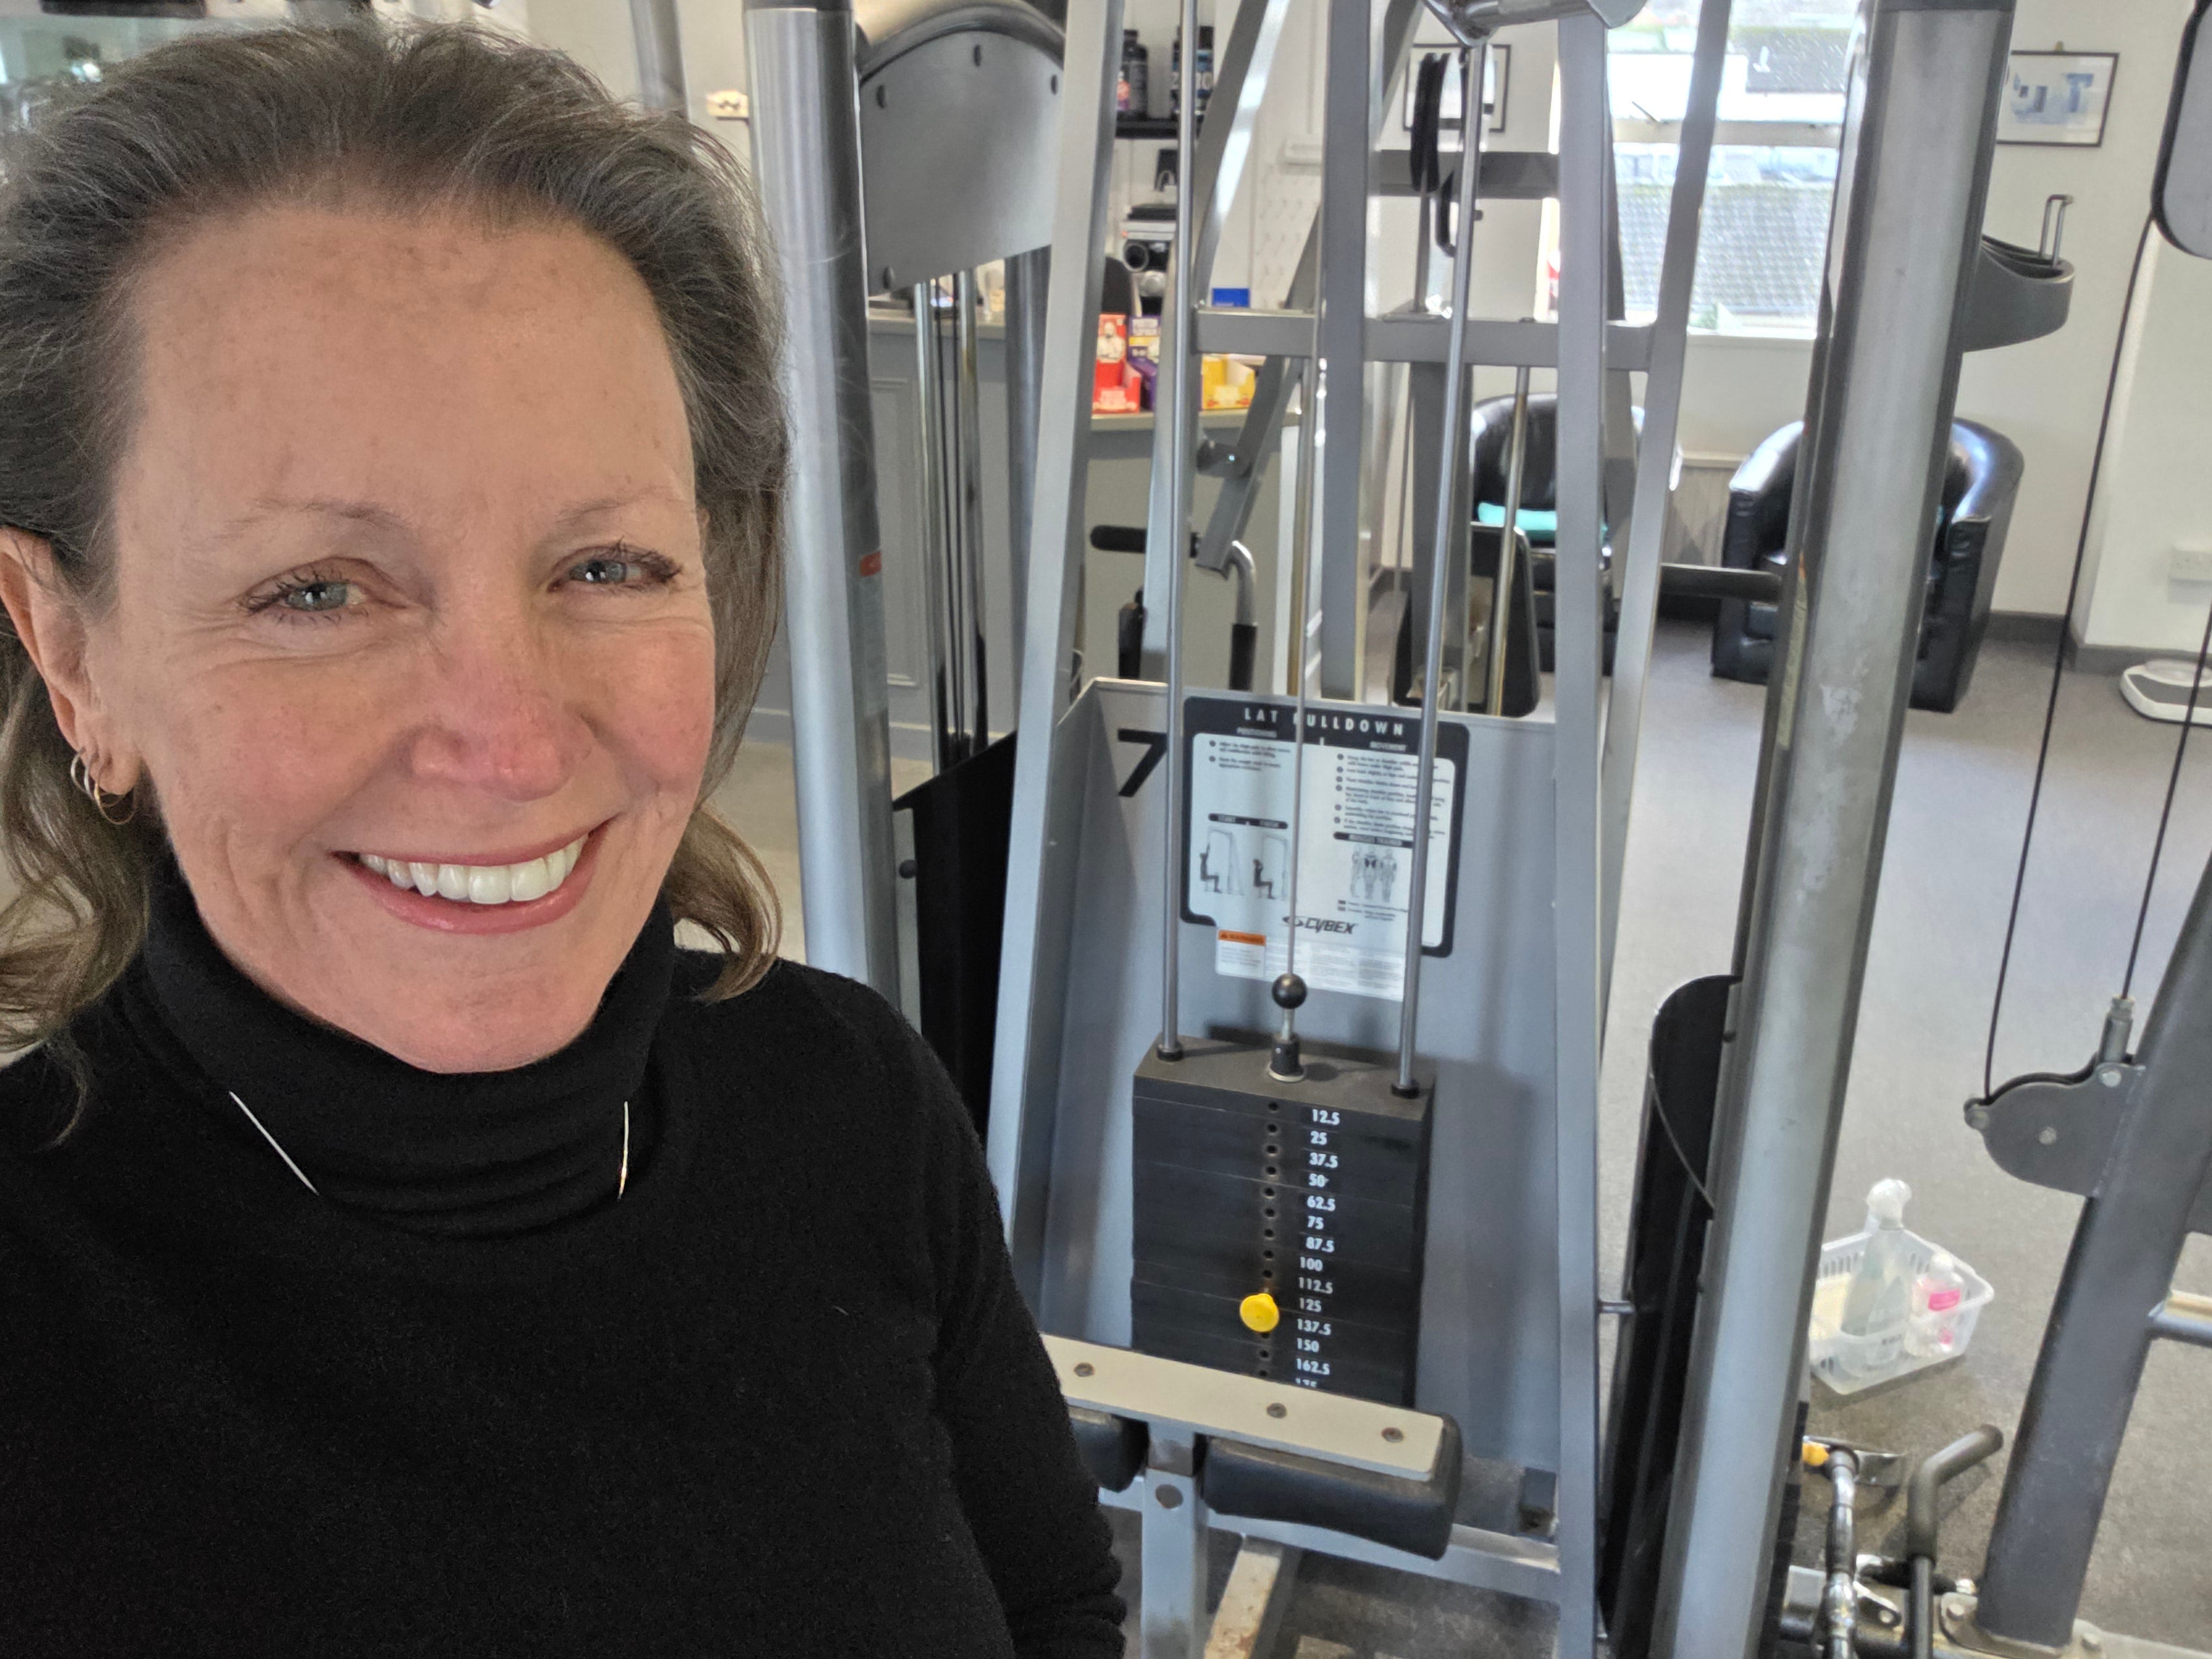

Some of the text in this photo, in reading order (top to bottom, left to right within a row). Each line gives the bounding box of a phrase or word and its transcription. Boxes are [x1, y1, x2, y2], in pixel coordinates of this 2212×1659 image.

[1244, 708, 1278, 723] LAT
[1118, 728, 1167, 798] 7
[1305, 918, 1356, 934] CYBEX
[1312, 1109, 1340, 1126] 12.5
[1310, 1130, 1328, 1146] 25
[1309, 1152, 1338, 1169] 37.5
[1308, 1173, 1326, 1188] 50
[1306, 1195, 1336, 1212] 62.5
[1307, 1215, 1324, 1230] 75
[1306, 1236, 1335, 1253] 87.5
[1300, 1256, 1323, 1272] 100
[1299, 1277, 1333, 1294] 112.5
[1299, 1298, 1322, 1313] 125
[1297, 1318, 1332, 1336] 137.5
[1297, 1338, 1320, 1353] 150
[1296, 1358, 1330, 1375] 162.5
